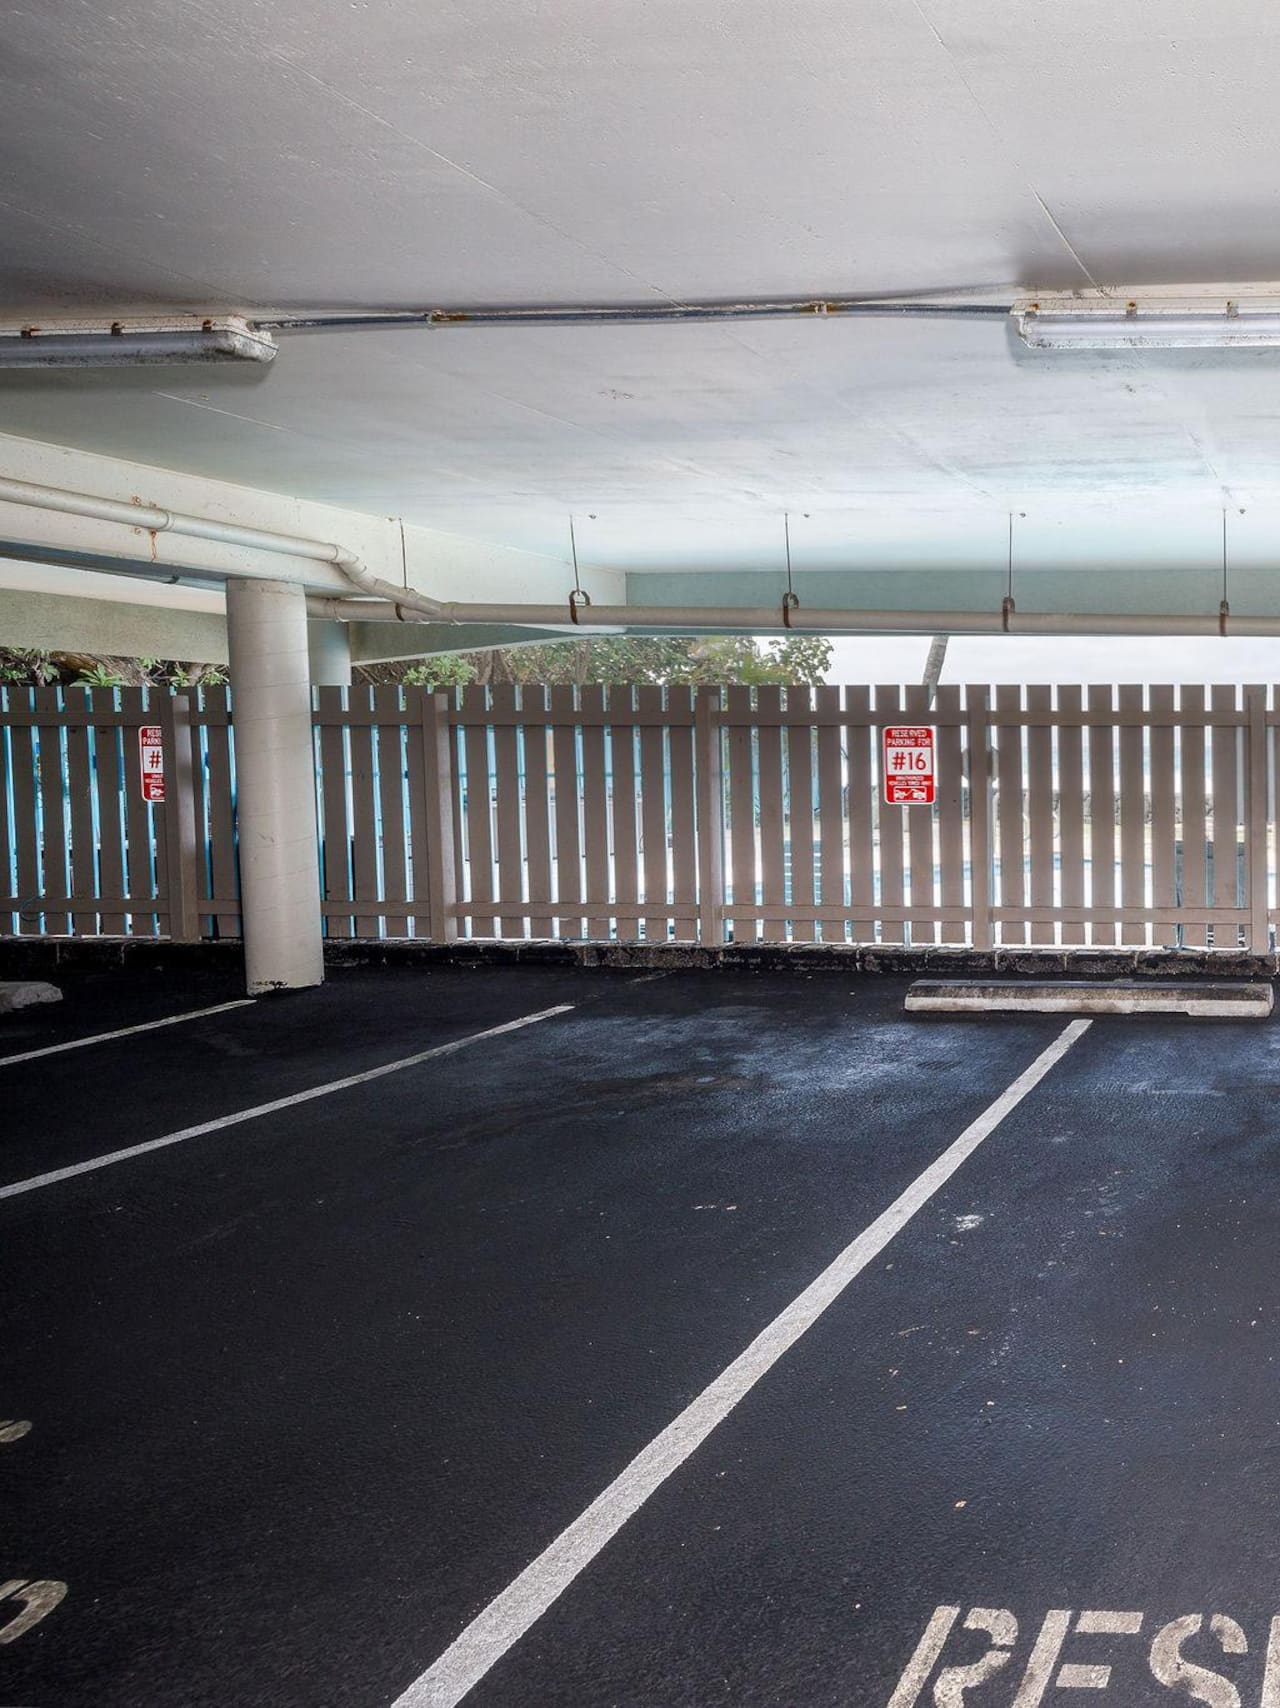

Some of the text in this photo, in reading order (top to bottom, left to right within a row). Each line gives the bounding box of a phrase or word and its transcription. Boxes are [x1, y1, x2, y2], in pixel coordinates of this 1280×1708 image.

[147, 729, 162, 737] RESE
[891, 729, 927, 737] RESERVED
[887, 738, 931, 746] PARKING FOR
[892, 751, 926, 770] #16
